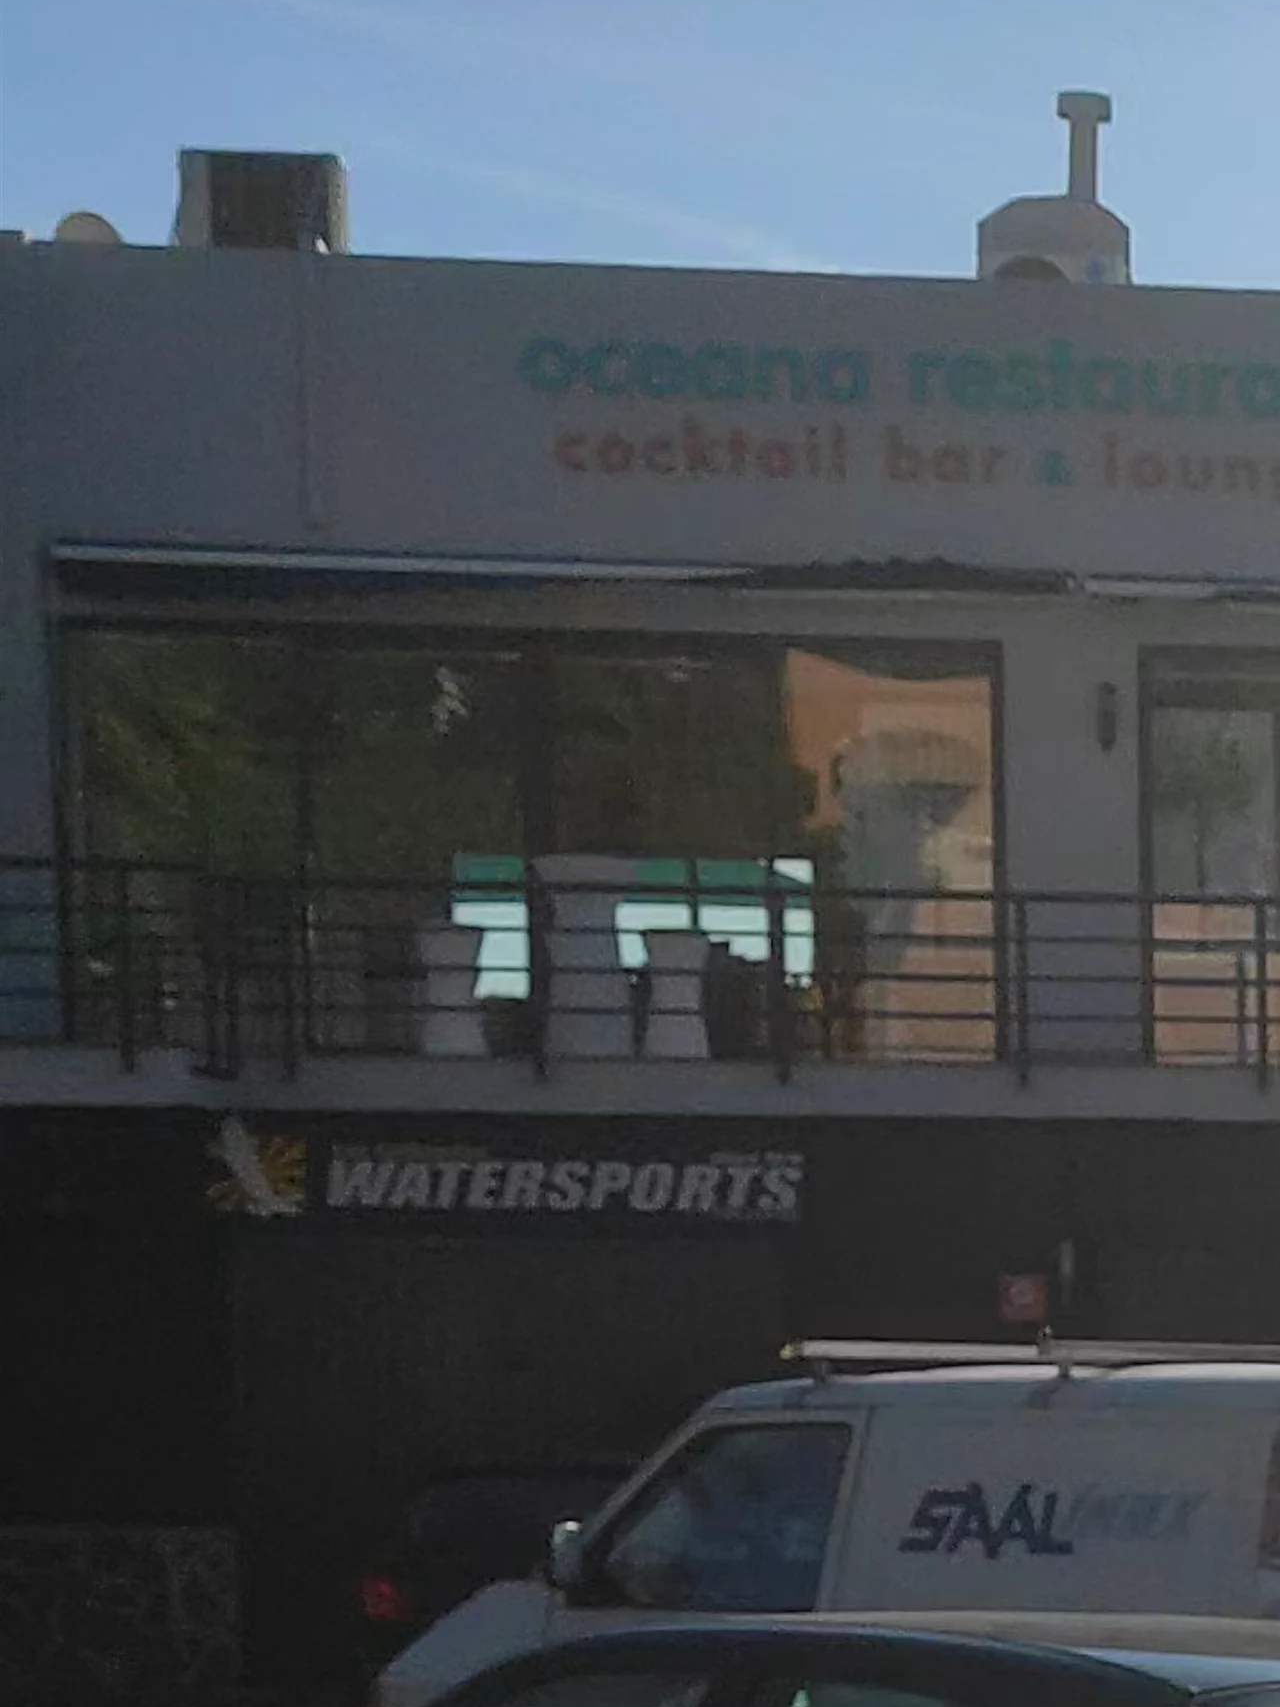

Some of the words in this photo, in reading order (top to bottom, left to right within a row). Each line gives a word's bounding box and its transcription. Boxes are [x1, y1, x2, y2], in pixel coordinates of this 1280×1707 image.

[517, 335, 871, 402] oceana
[553, 416, 847, 482] cocktail
[884, 424, 1006, 484] bar
[328, 1159, 803, 1212] WATERSPORTS
